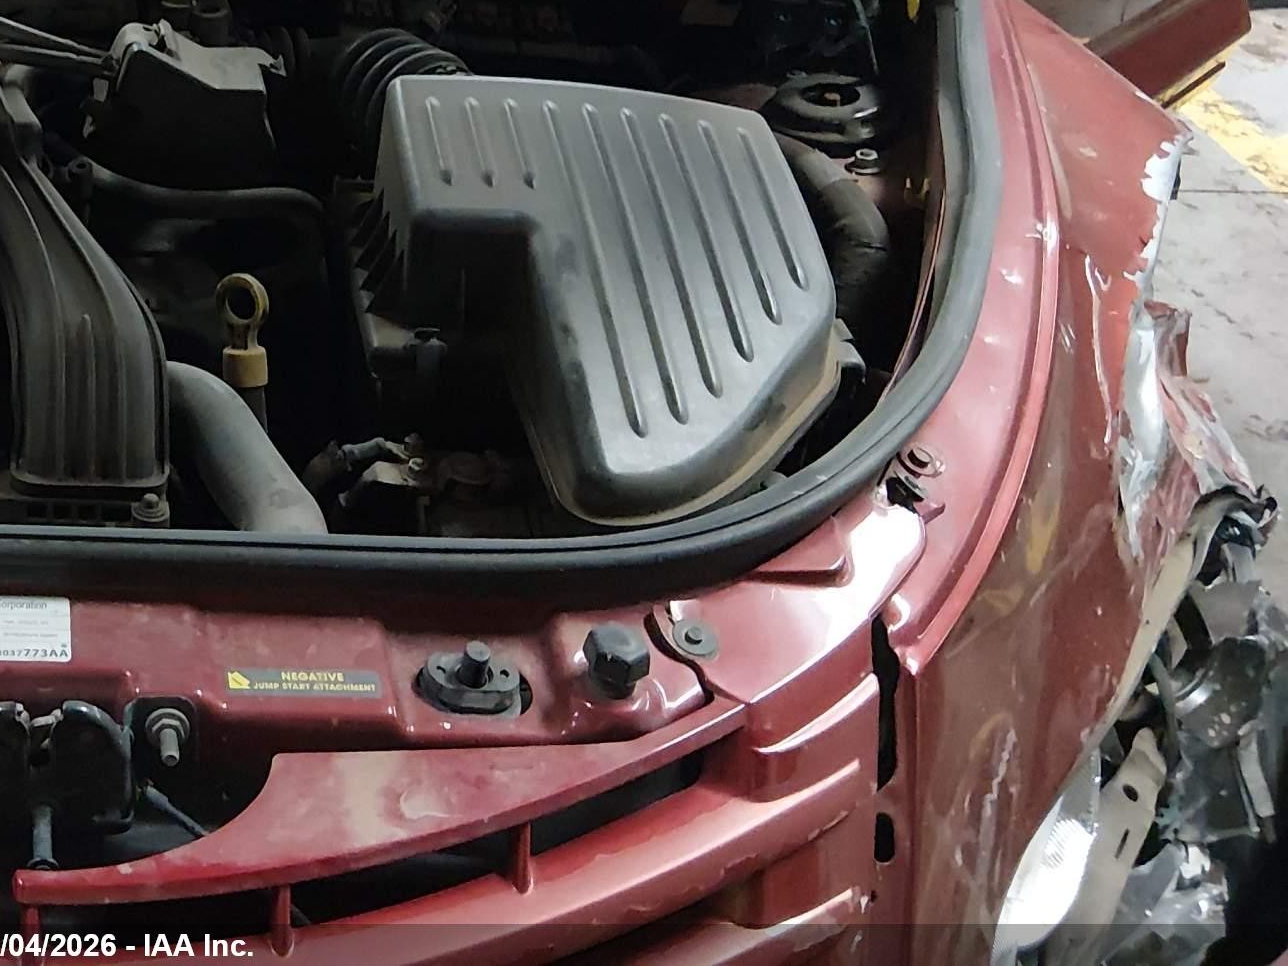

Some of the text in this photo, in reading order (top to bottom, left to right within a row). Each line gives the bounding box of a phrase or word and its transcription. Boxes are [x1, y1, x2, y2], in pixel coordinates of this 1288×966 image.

[280, 671, 344, 682] NEGATIVE
[253, 682, 376, 692] JUMP START ATTACHMENT
